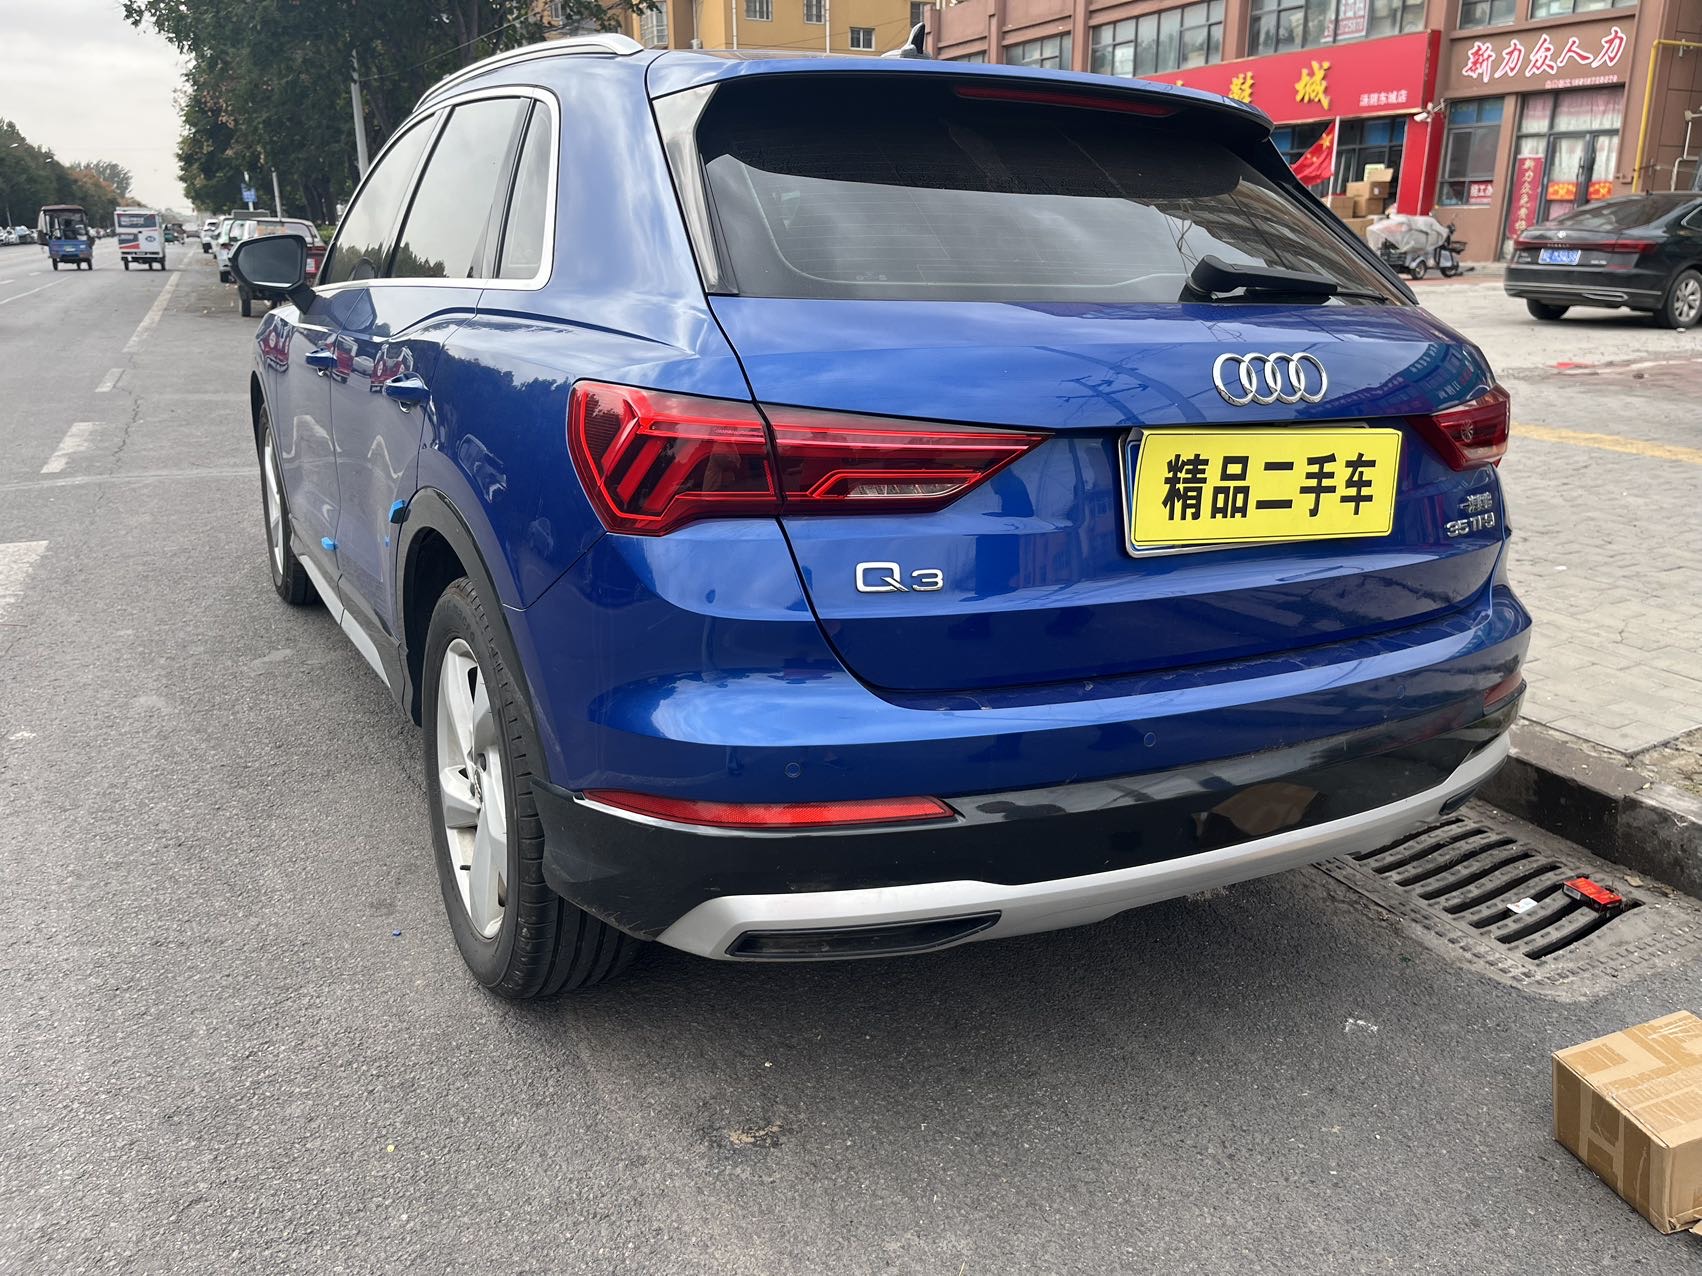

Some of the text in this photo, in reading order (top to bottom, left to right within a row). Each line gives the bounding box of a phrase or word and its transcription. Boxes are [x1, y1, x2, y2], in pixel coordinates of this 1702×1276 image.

[1462, 26, 1627, 83] 新力众人力
[1162, 453, 1376, 521] 精品二手车
[855, 561, 944, 593] Q3
